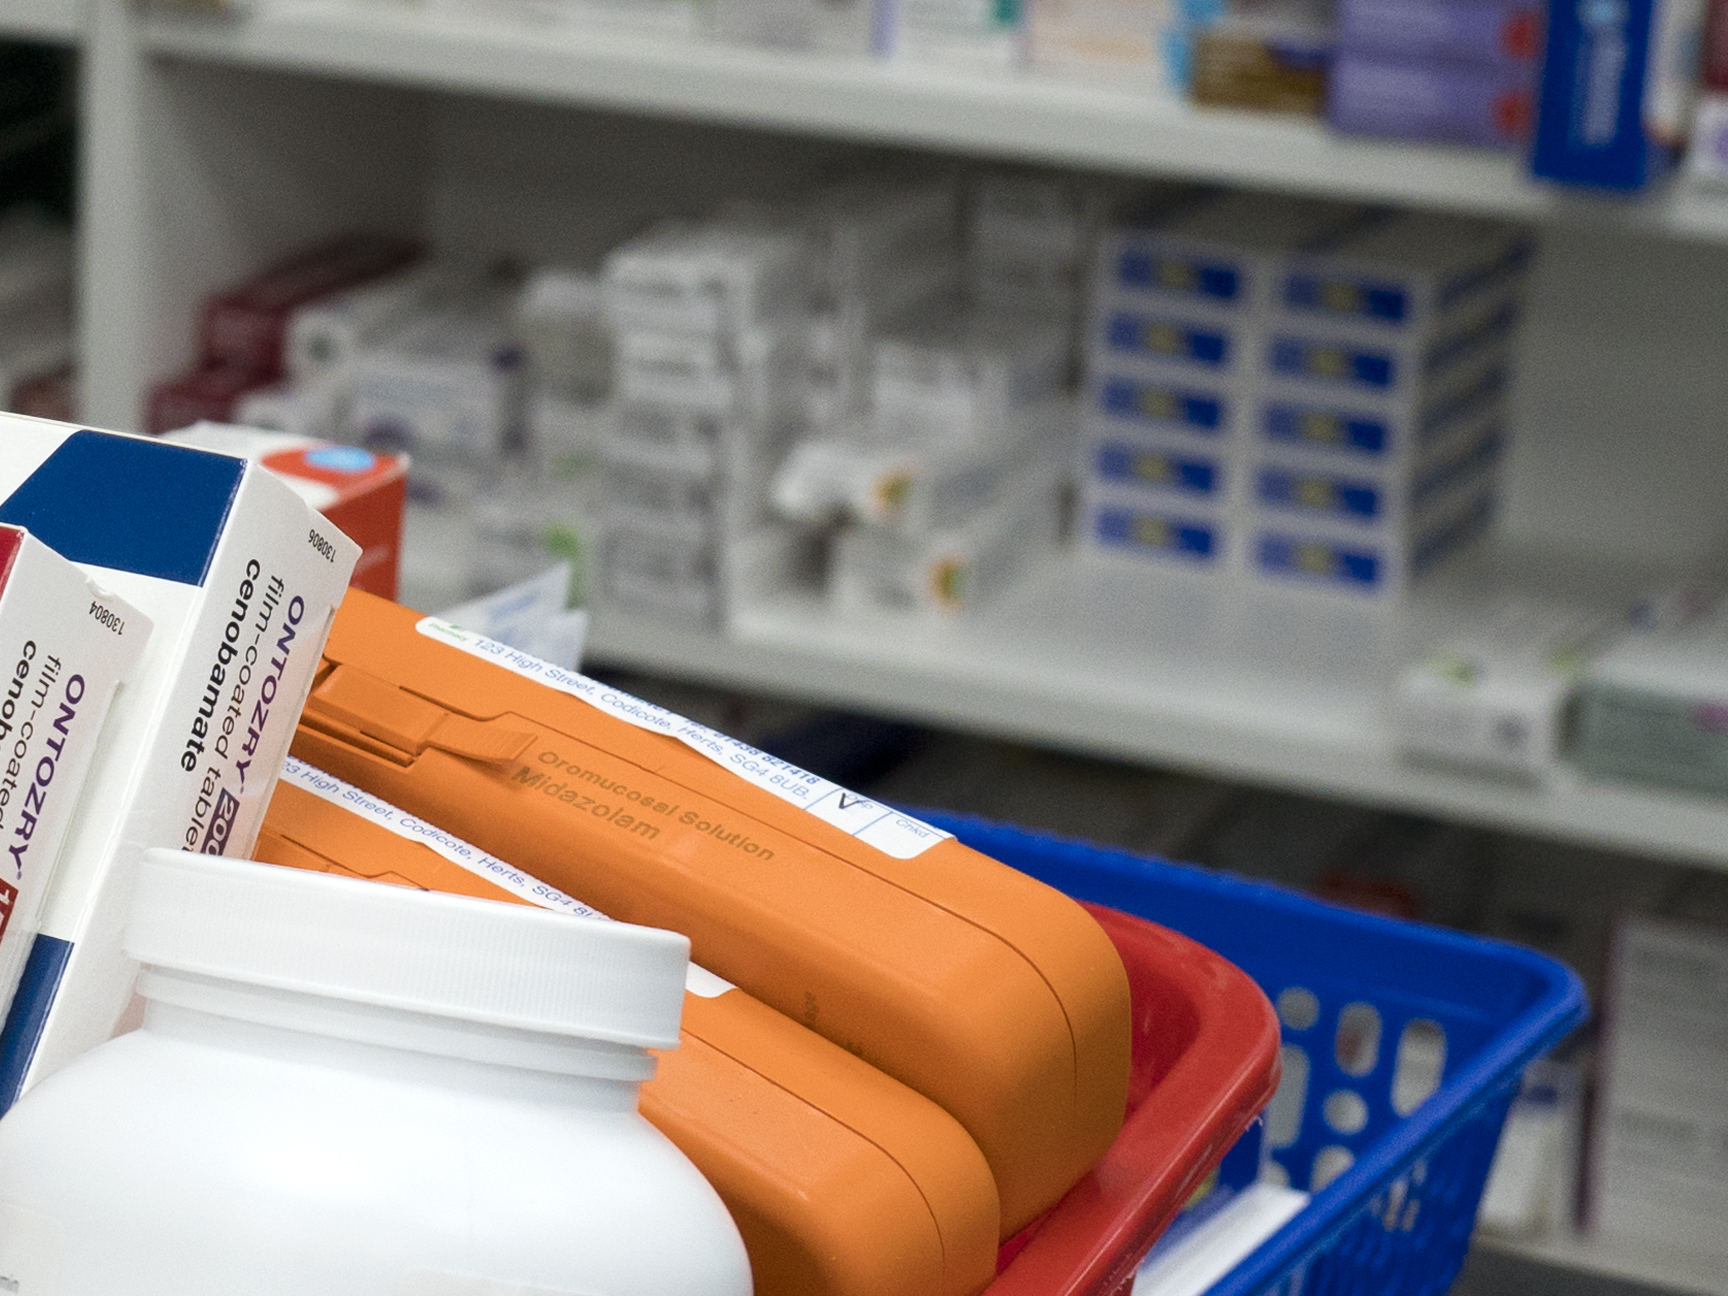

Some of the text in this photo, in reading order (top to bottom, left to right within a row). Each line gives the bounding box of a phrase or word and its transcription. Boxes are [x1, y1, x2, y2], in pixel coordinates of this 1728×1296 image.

[309, 529, 337, 564] 130806
[89, 600, 125, 636] 130804
[181, 559, 262, 773] cenobamate
[182, 575, 285, 853] film-coated table
[471, 633, 811, 802] 123 High Street, Codicote, Herts, SG4 8UB.
[511, 759, 664, 848] Midazolam
[534, 741, 777, 867] Oromucosal Solution
